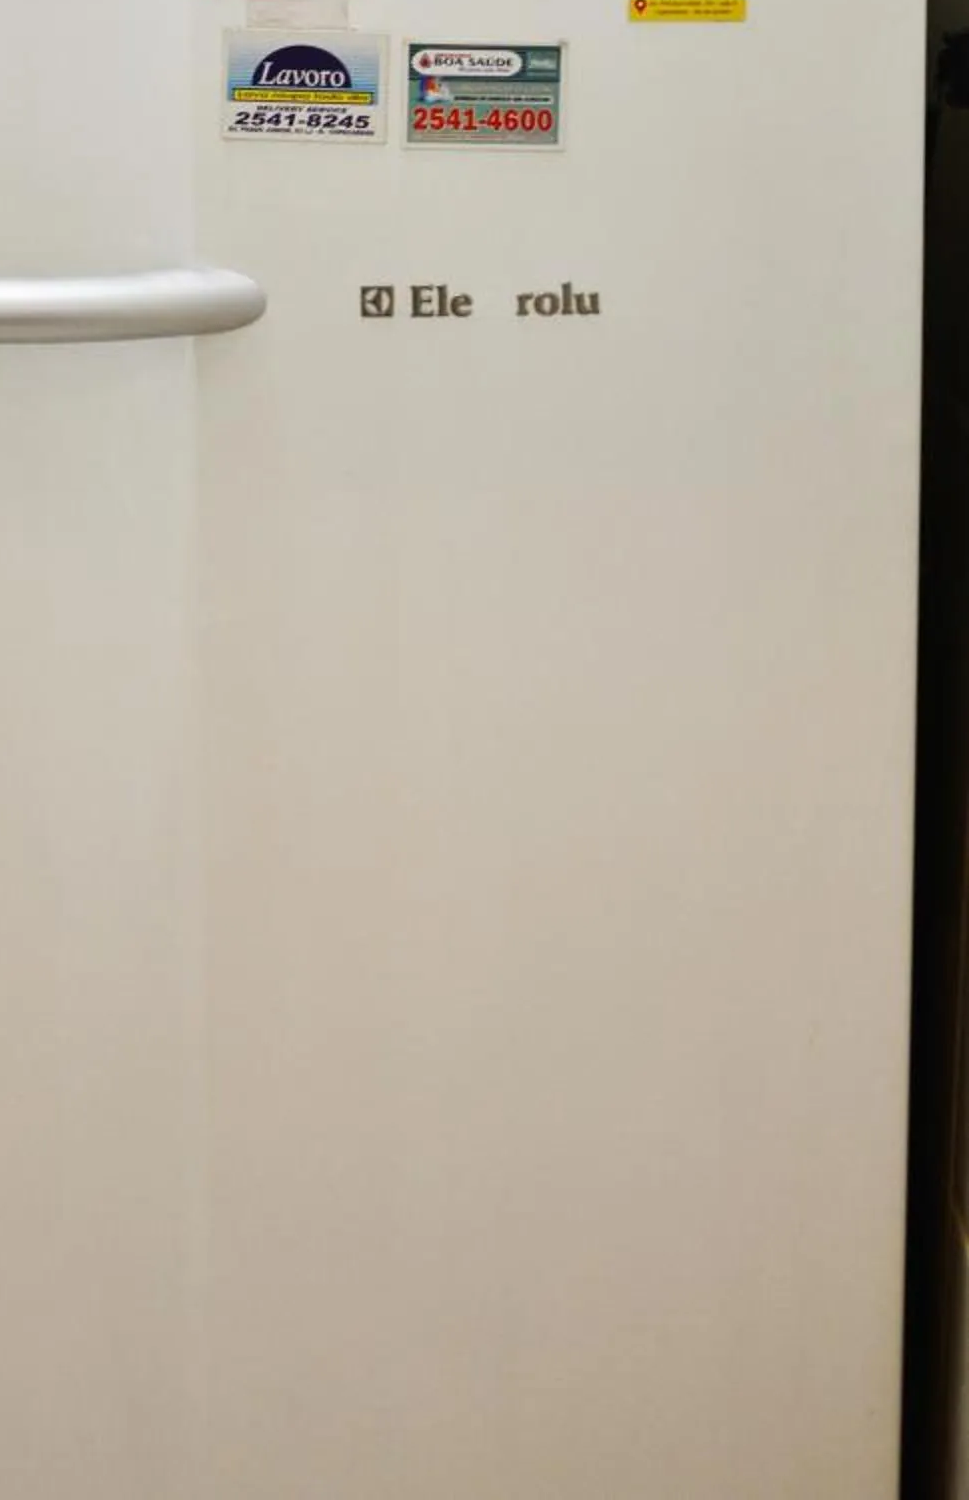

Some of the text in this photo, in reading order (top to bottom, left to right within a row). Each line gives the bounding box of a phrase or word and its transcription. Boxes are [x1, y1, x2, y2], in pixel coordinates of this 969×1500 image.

[434, 57, 464, 67] BOA
[258, 61, 346, 87] Lavoro
[234, 111, 371, 129] 2541-8245
[412, 106, 553, 132] 2541-4600
